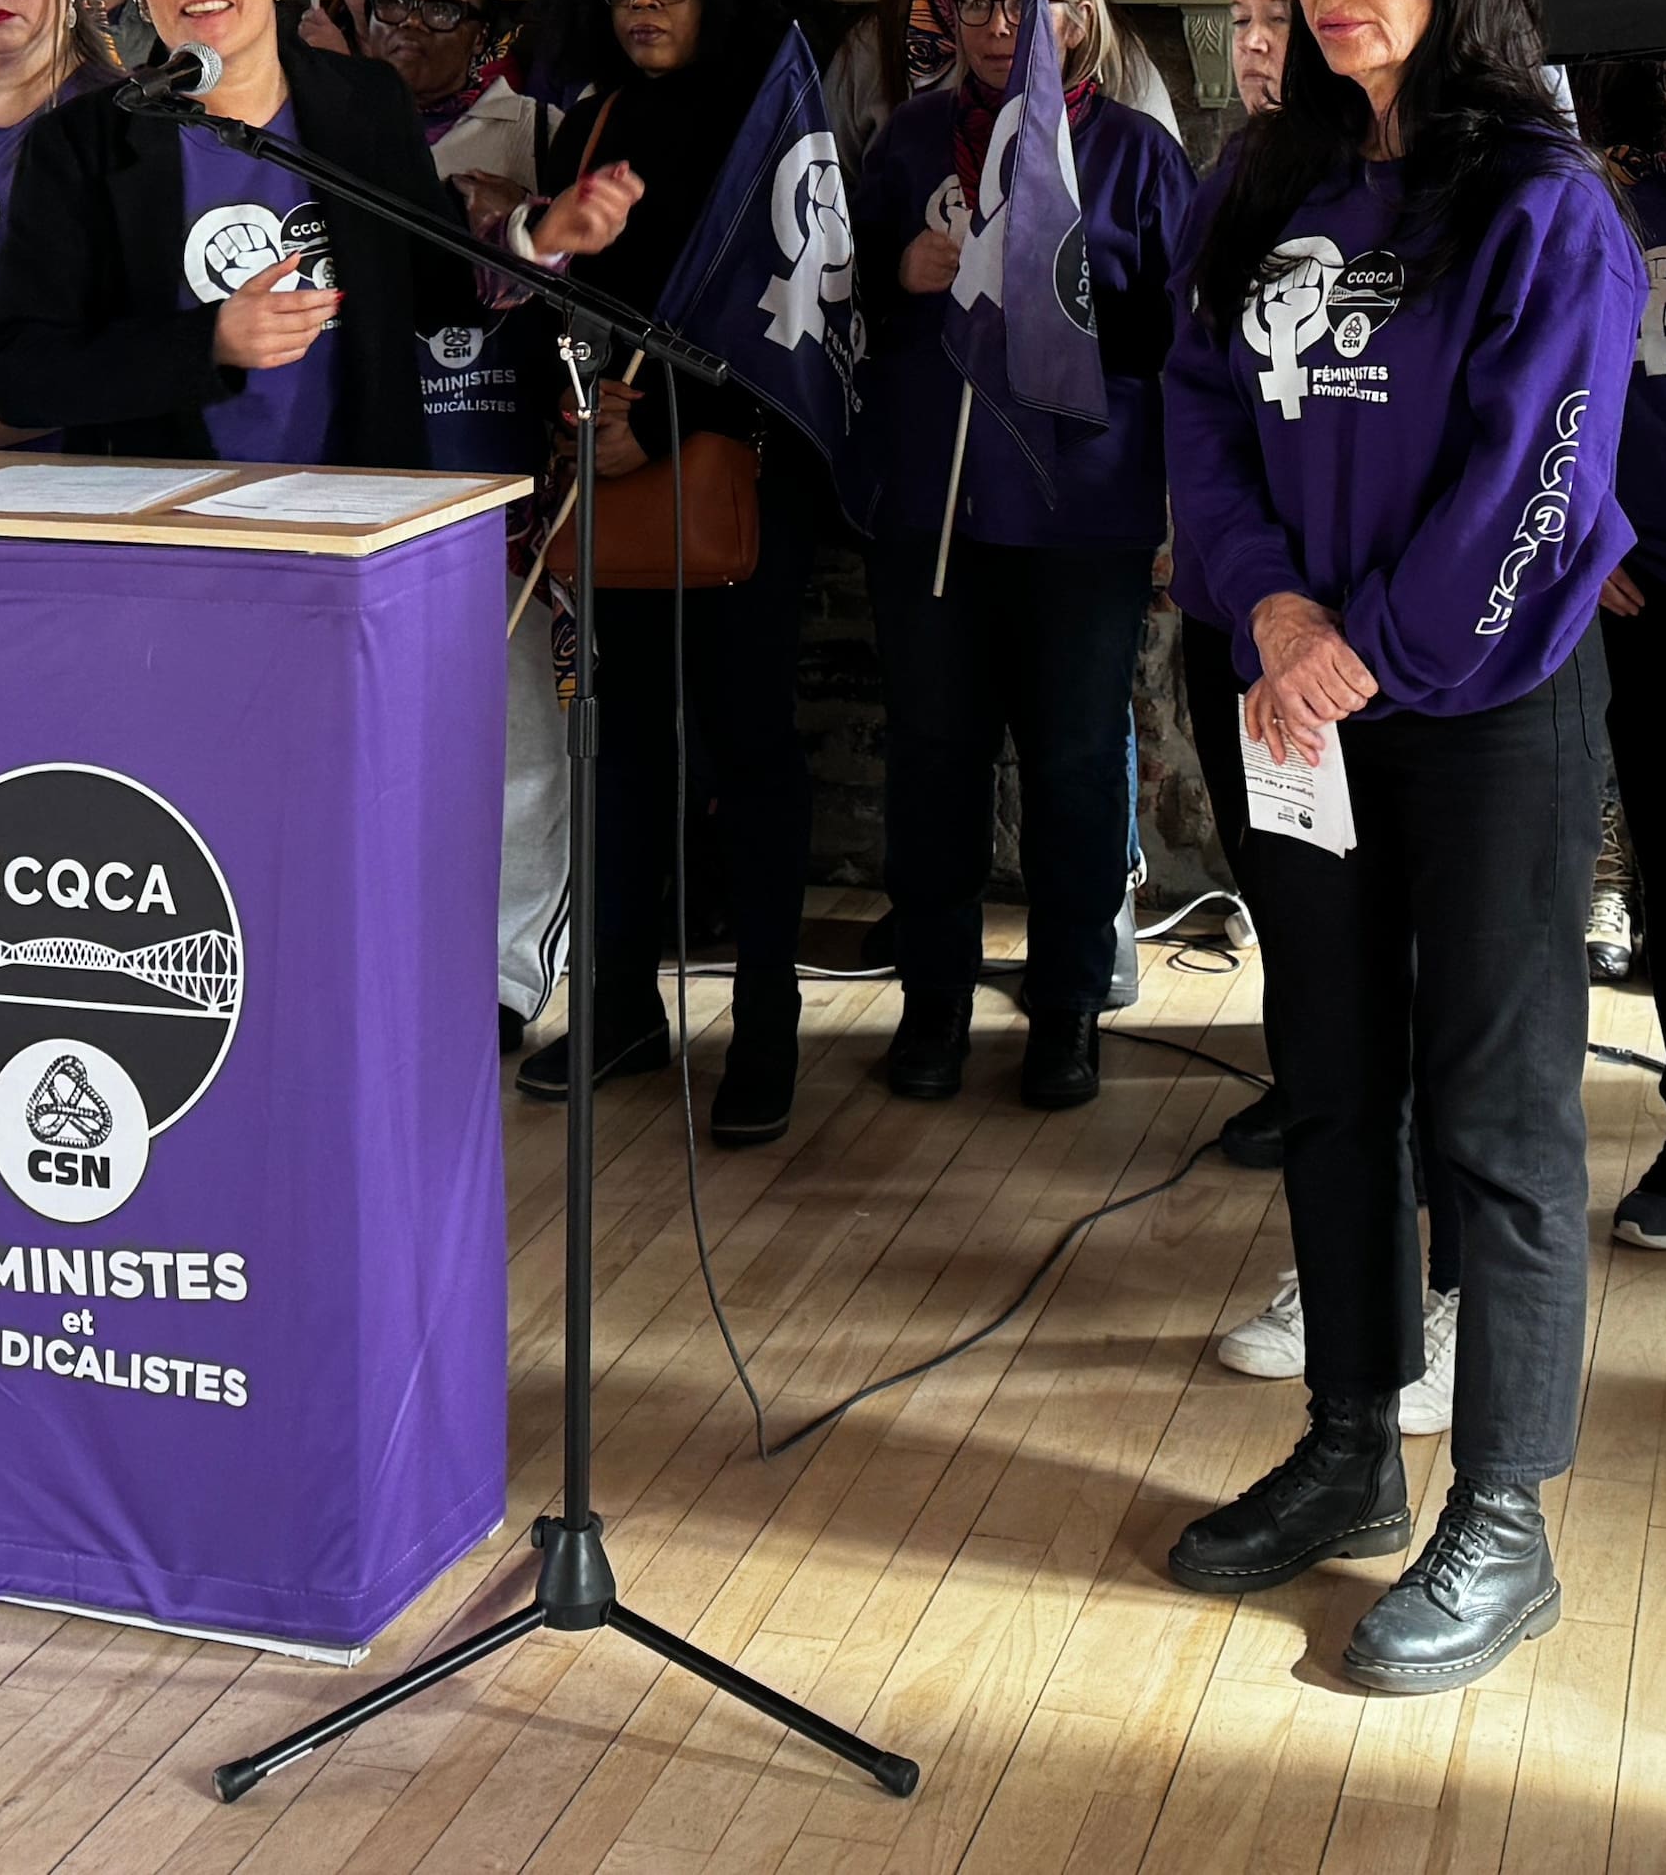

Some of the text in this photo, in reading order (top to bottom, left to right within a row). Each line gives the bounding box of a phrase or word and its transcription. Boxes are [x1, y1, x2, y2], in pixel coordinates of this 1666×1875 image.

[1346, 271, 1394, 285] CCQCA
[1342, 338, 1361, 349] CSN
[443, 346, 472, 359] CSN
[27, 1150, 111, 1189] CSN
[61, 1308, 95, 1337] et
